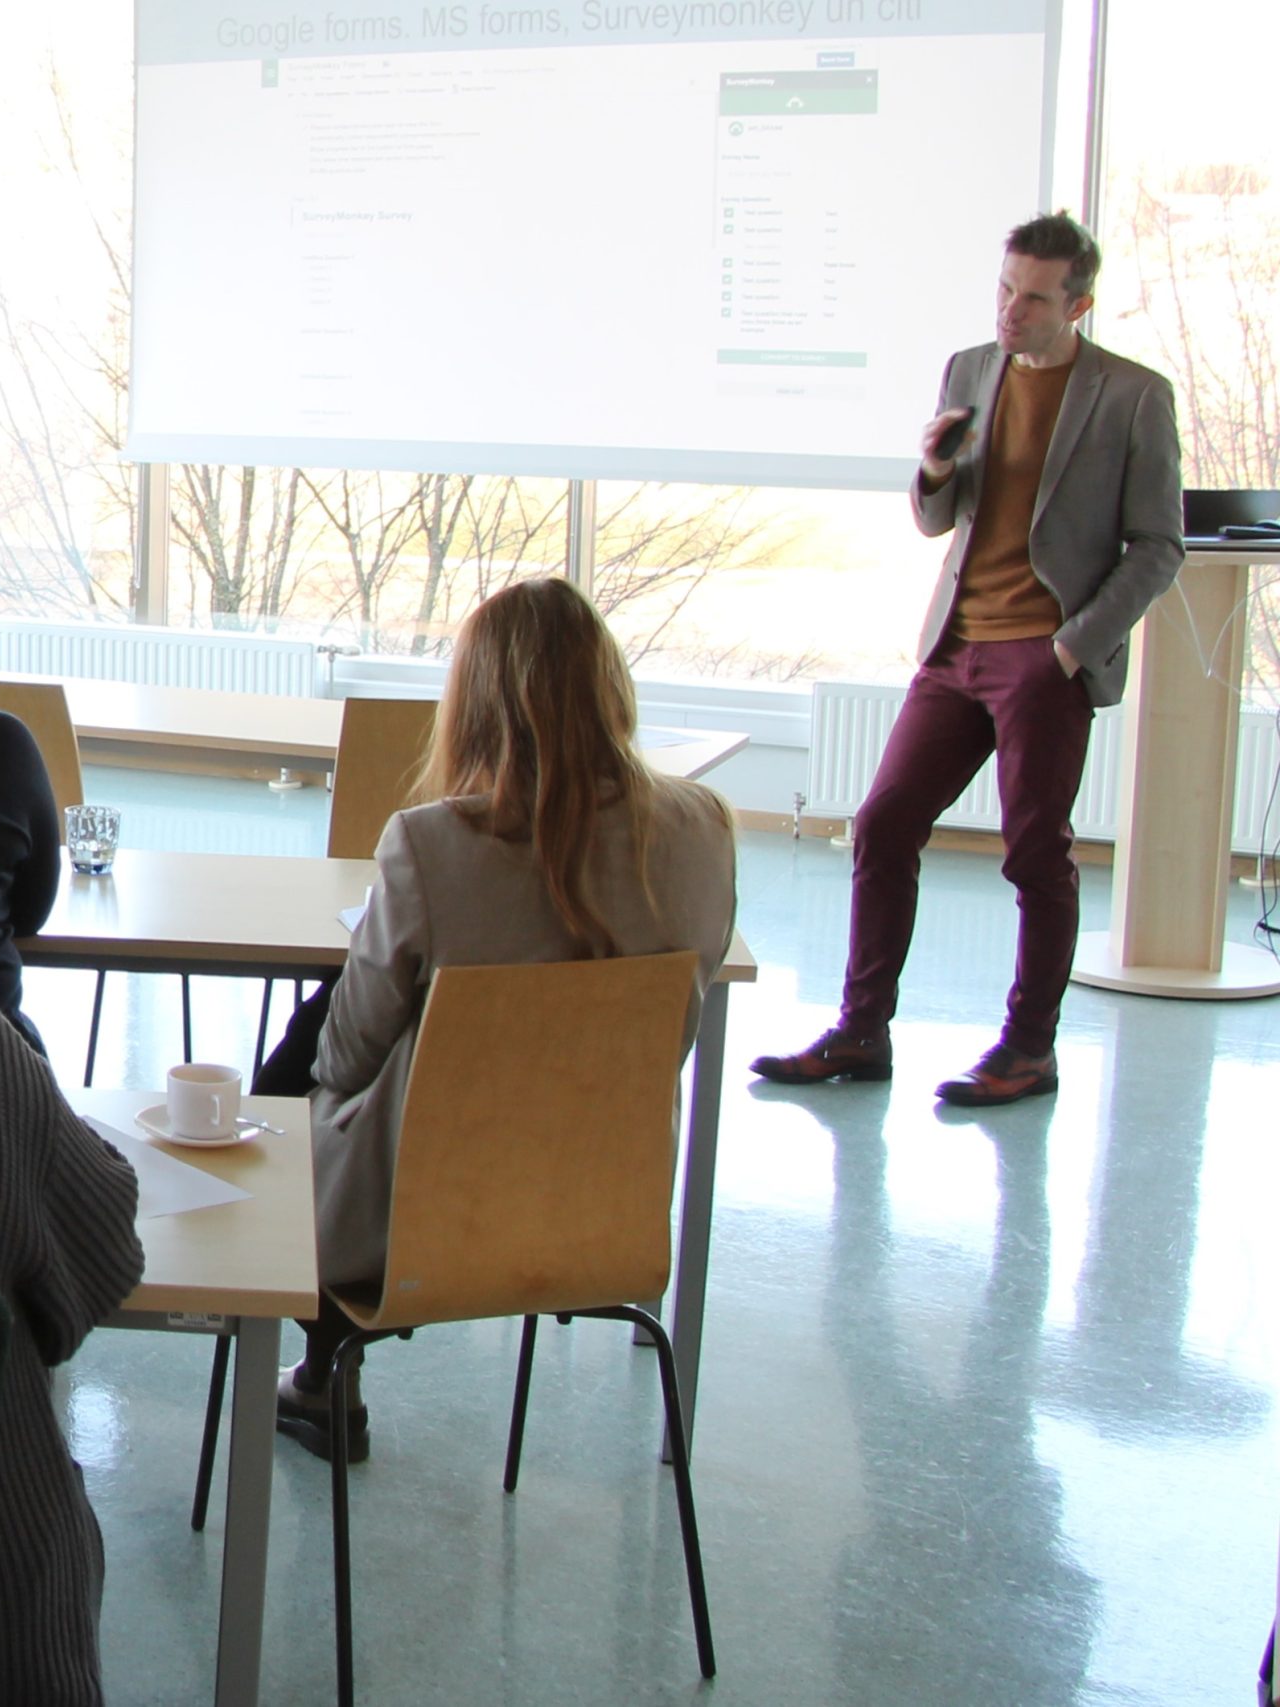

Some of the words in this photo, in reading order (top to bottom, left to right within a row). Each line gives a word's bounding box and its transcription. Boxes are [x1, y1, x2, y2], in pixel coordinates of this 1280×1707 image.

[216, 14, 314, 52] Google
[422, 5, 469, 38] MS
[581, 0, 814, 37] Surveymonkey
[826, 0, 865, 23] un
[302, 209, 375, 223] SurveyMonkey
[377, 209, 415, 223] Survey
